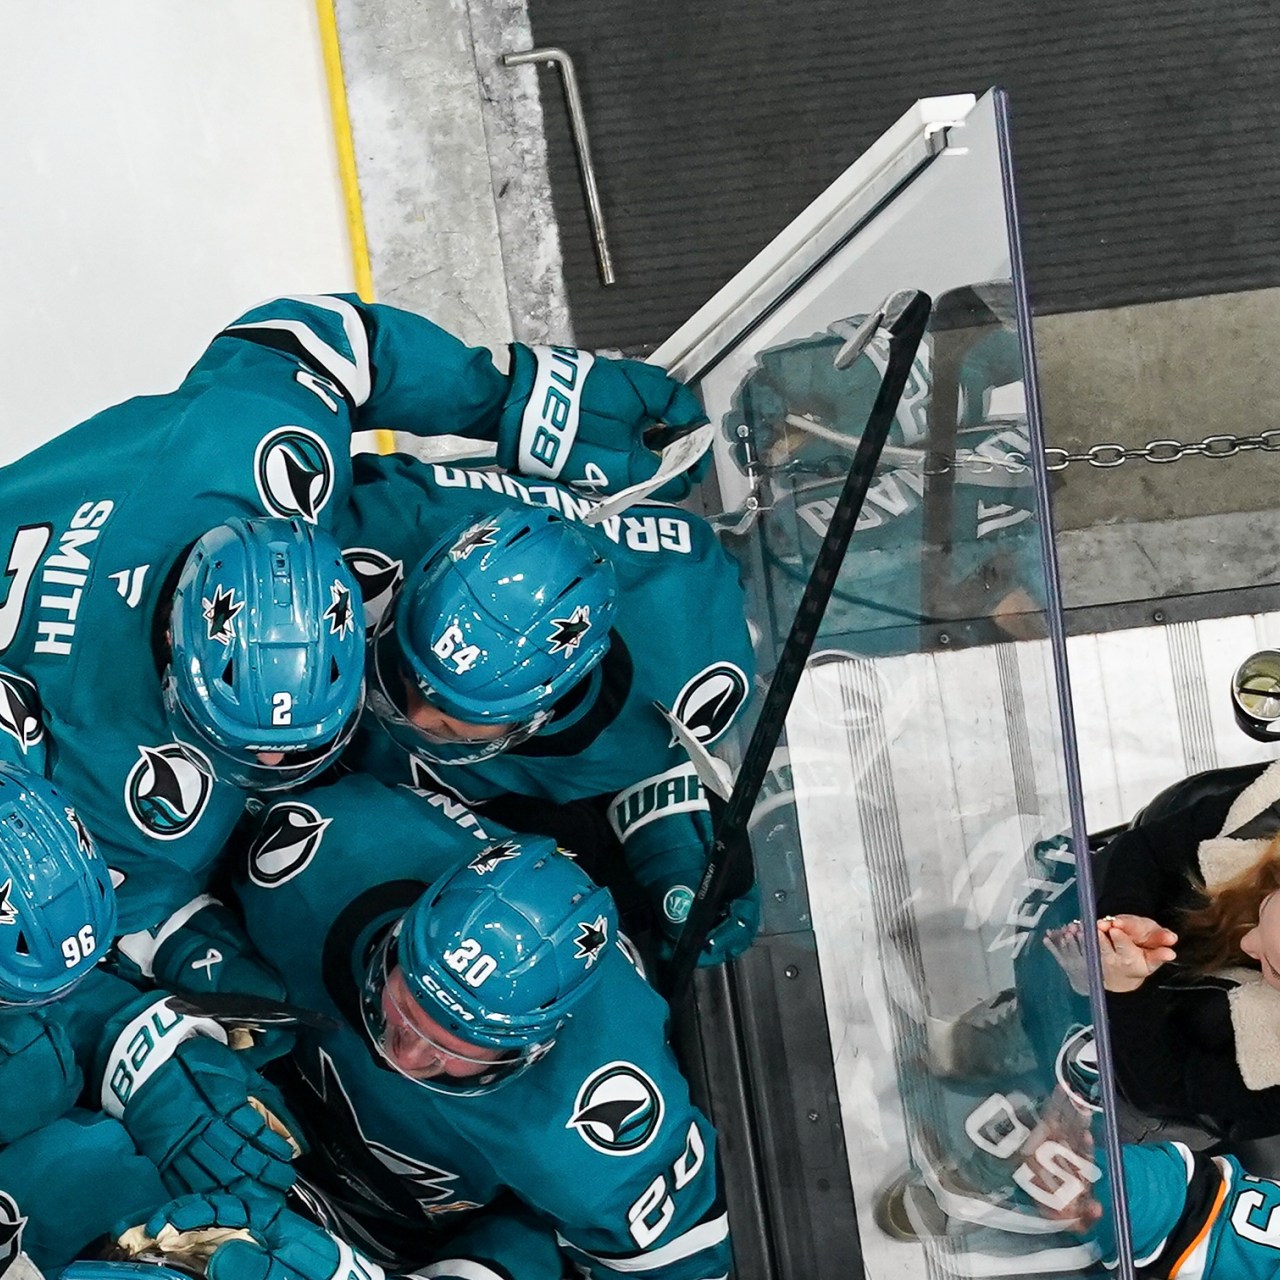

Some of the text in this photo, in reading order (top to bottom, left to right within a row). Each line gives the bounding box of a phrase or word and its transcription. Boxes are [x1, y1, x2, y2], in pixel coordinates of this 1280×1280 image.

[34, 500, 115, 656] SMITH
[430, 625, 482, 676] 64
[272, 691, 292, 726] 2
[62, 924, 96, 969] 96
[442, 937, 498, 988] 20
[421, 974, 476, 1021] CCM
[627, 1120, 705, 1250] 20
